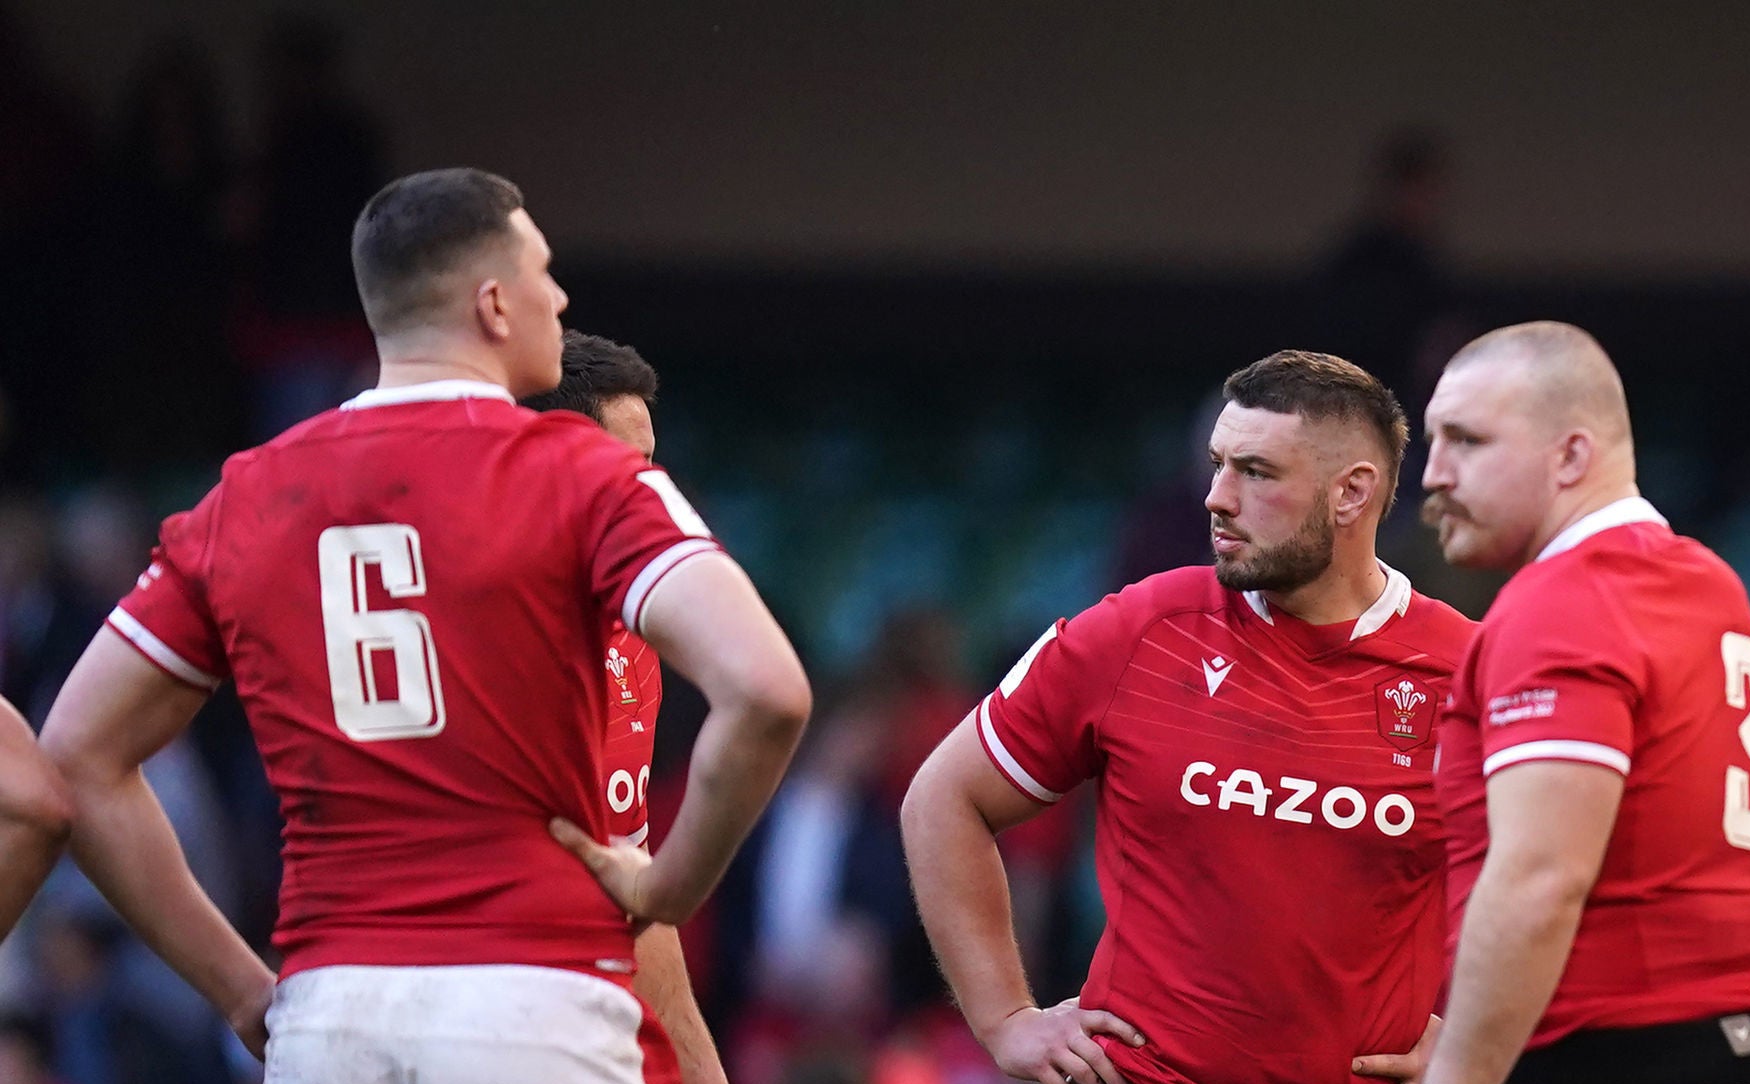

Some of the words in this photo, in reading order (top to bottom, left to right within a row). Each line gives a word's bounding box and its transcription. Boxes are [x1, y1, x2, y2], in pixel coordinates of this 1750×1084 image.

[318, 523, 447, 743] 6
[1394, 723, 1413, 734] WRU
[1392, 753, 1412, 768] 1169
[1179, 760, 1416, 838] CAZOO
